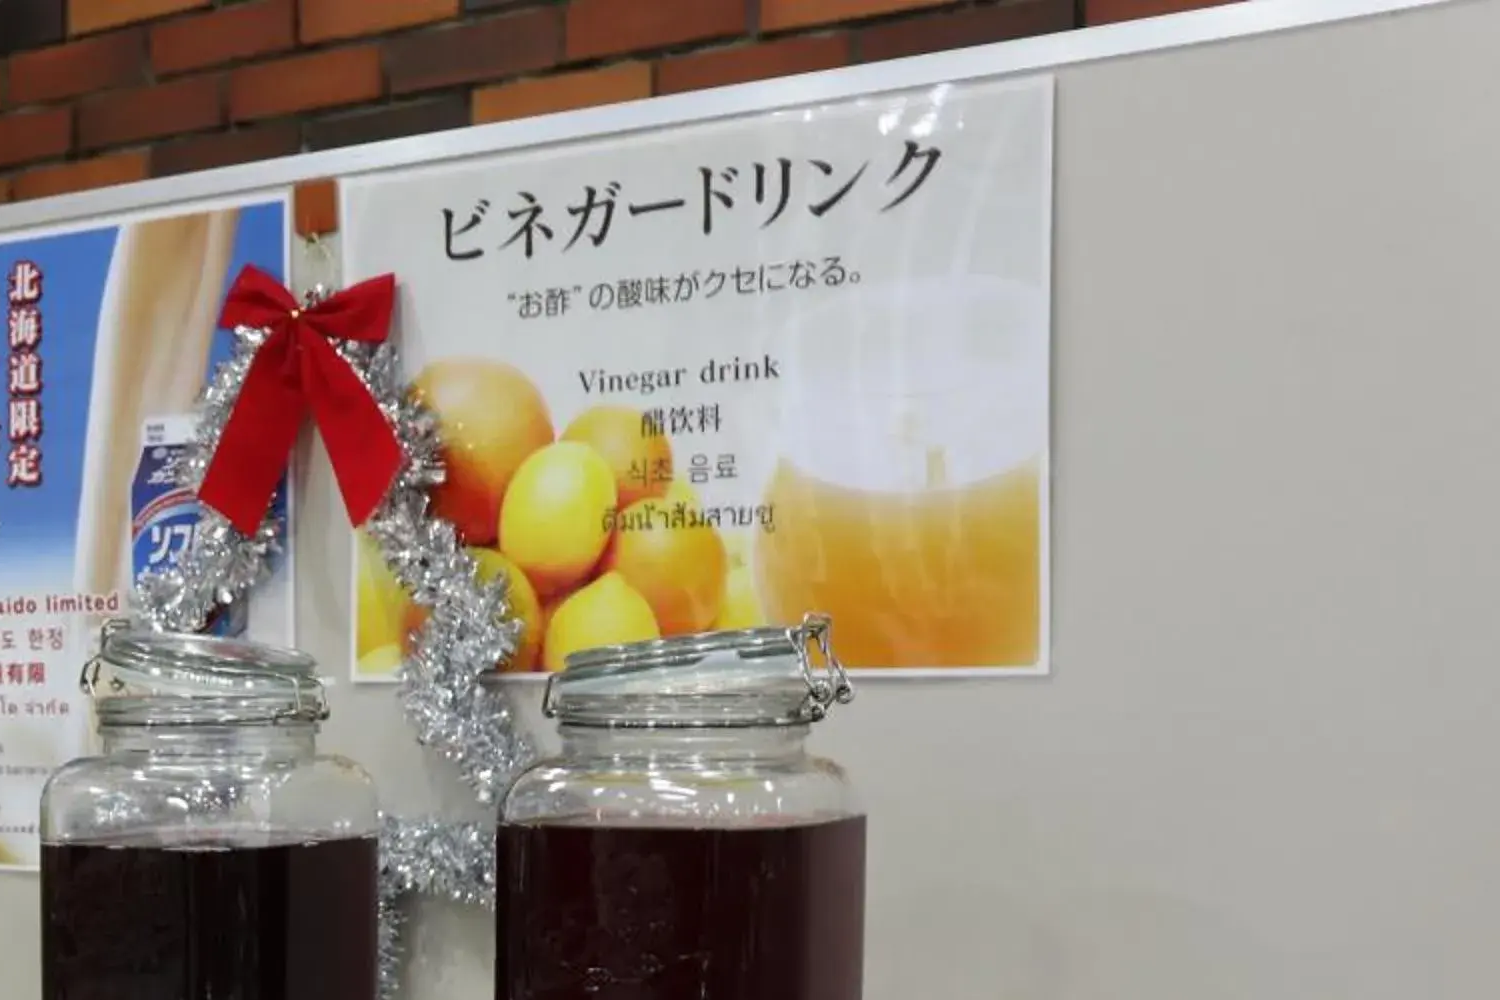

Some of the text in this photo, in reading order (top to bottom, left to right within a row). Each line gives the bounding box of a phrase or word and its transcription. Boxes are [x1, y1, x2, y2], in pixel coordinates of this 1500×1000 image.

[441, 139, 942, 261] ビネガードリンク
[8, 260, 41, 486] 北海道限定
[579, 354, 780, 395] Vinegar drink
[688, 453, 738, 483] 음료
[150, 524, 200, 563] ソフ
[46, 592, 120, 614] limited
[28, 627, 64, 651] 한정
